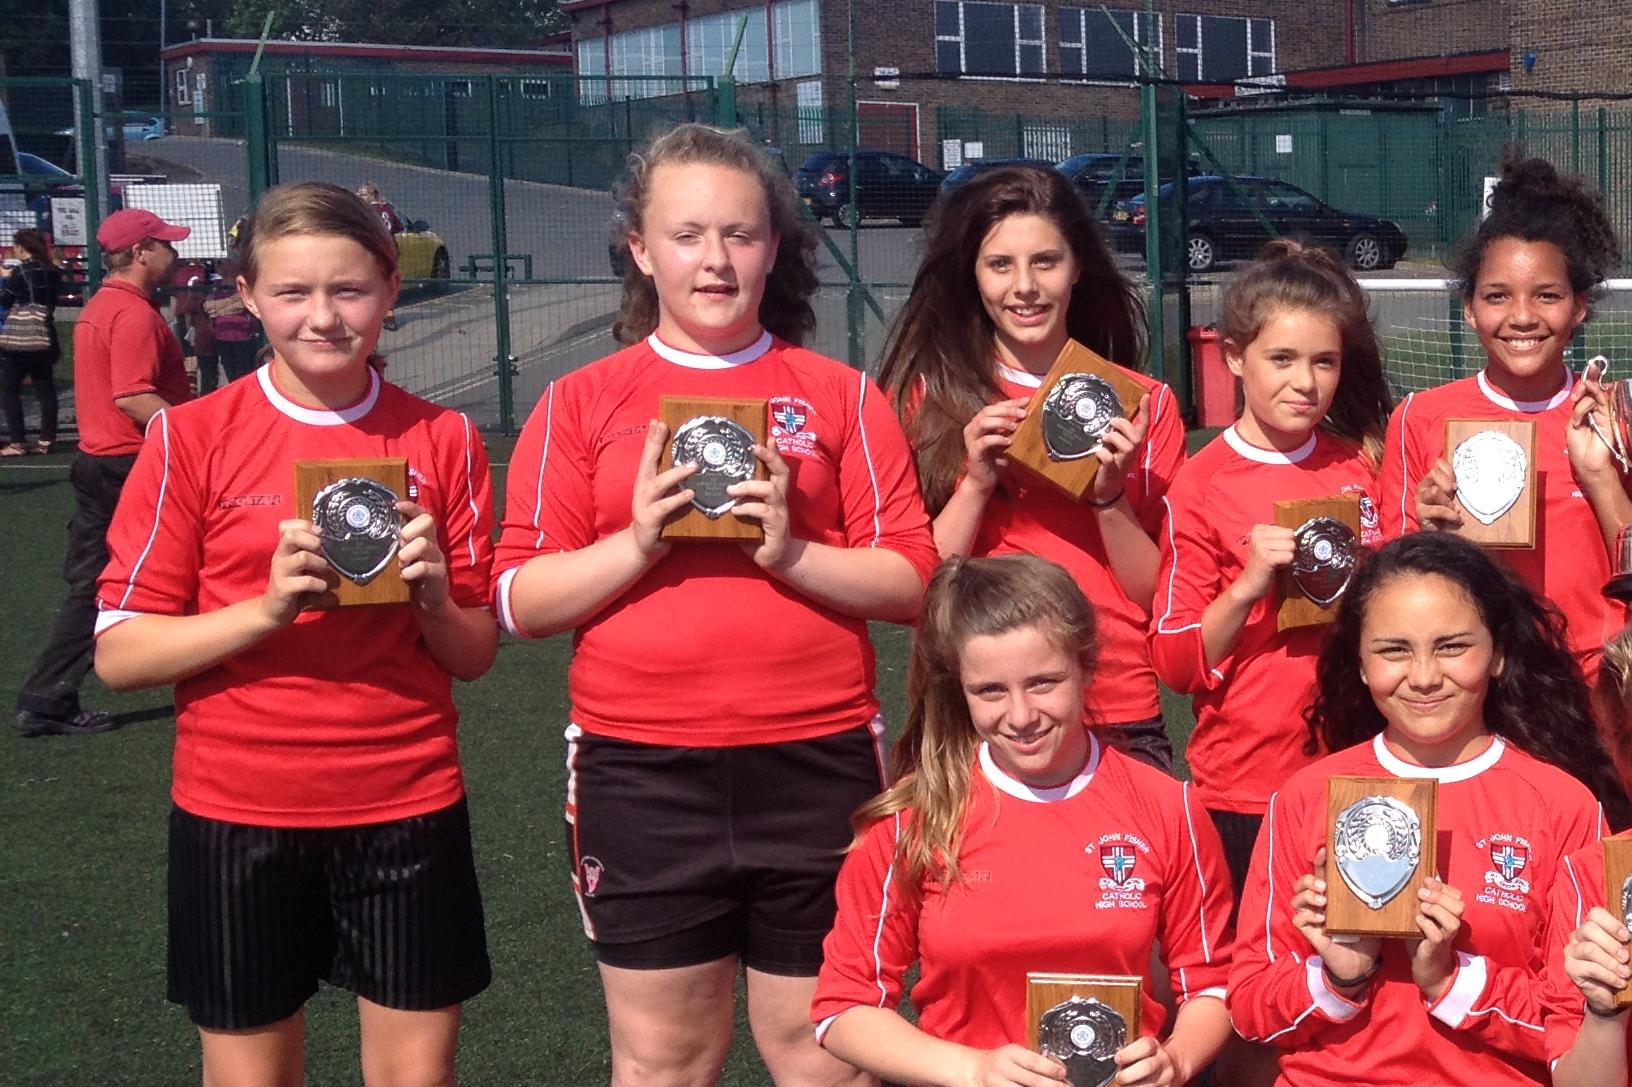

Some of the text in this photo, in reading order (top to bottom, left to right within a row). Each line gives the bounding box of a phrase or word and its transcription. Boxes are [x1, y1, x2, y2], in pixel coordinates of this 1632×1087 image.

[1084, 842, 1095, 854] ST
[1098, 832, 1121, 845] JOHN
[1101, 892, 1142, 900] CATHOLIC
[1484, 886, 1525, 902] CATHOLIC
[1094, 900, 1148, 910] HIGH SCHOOL
[1498, 897, 1528, 912] SCHOOL
